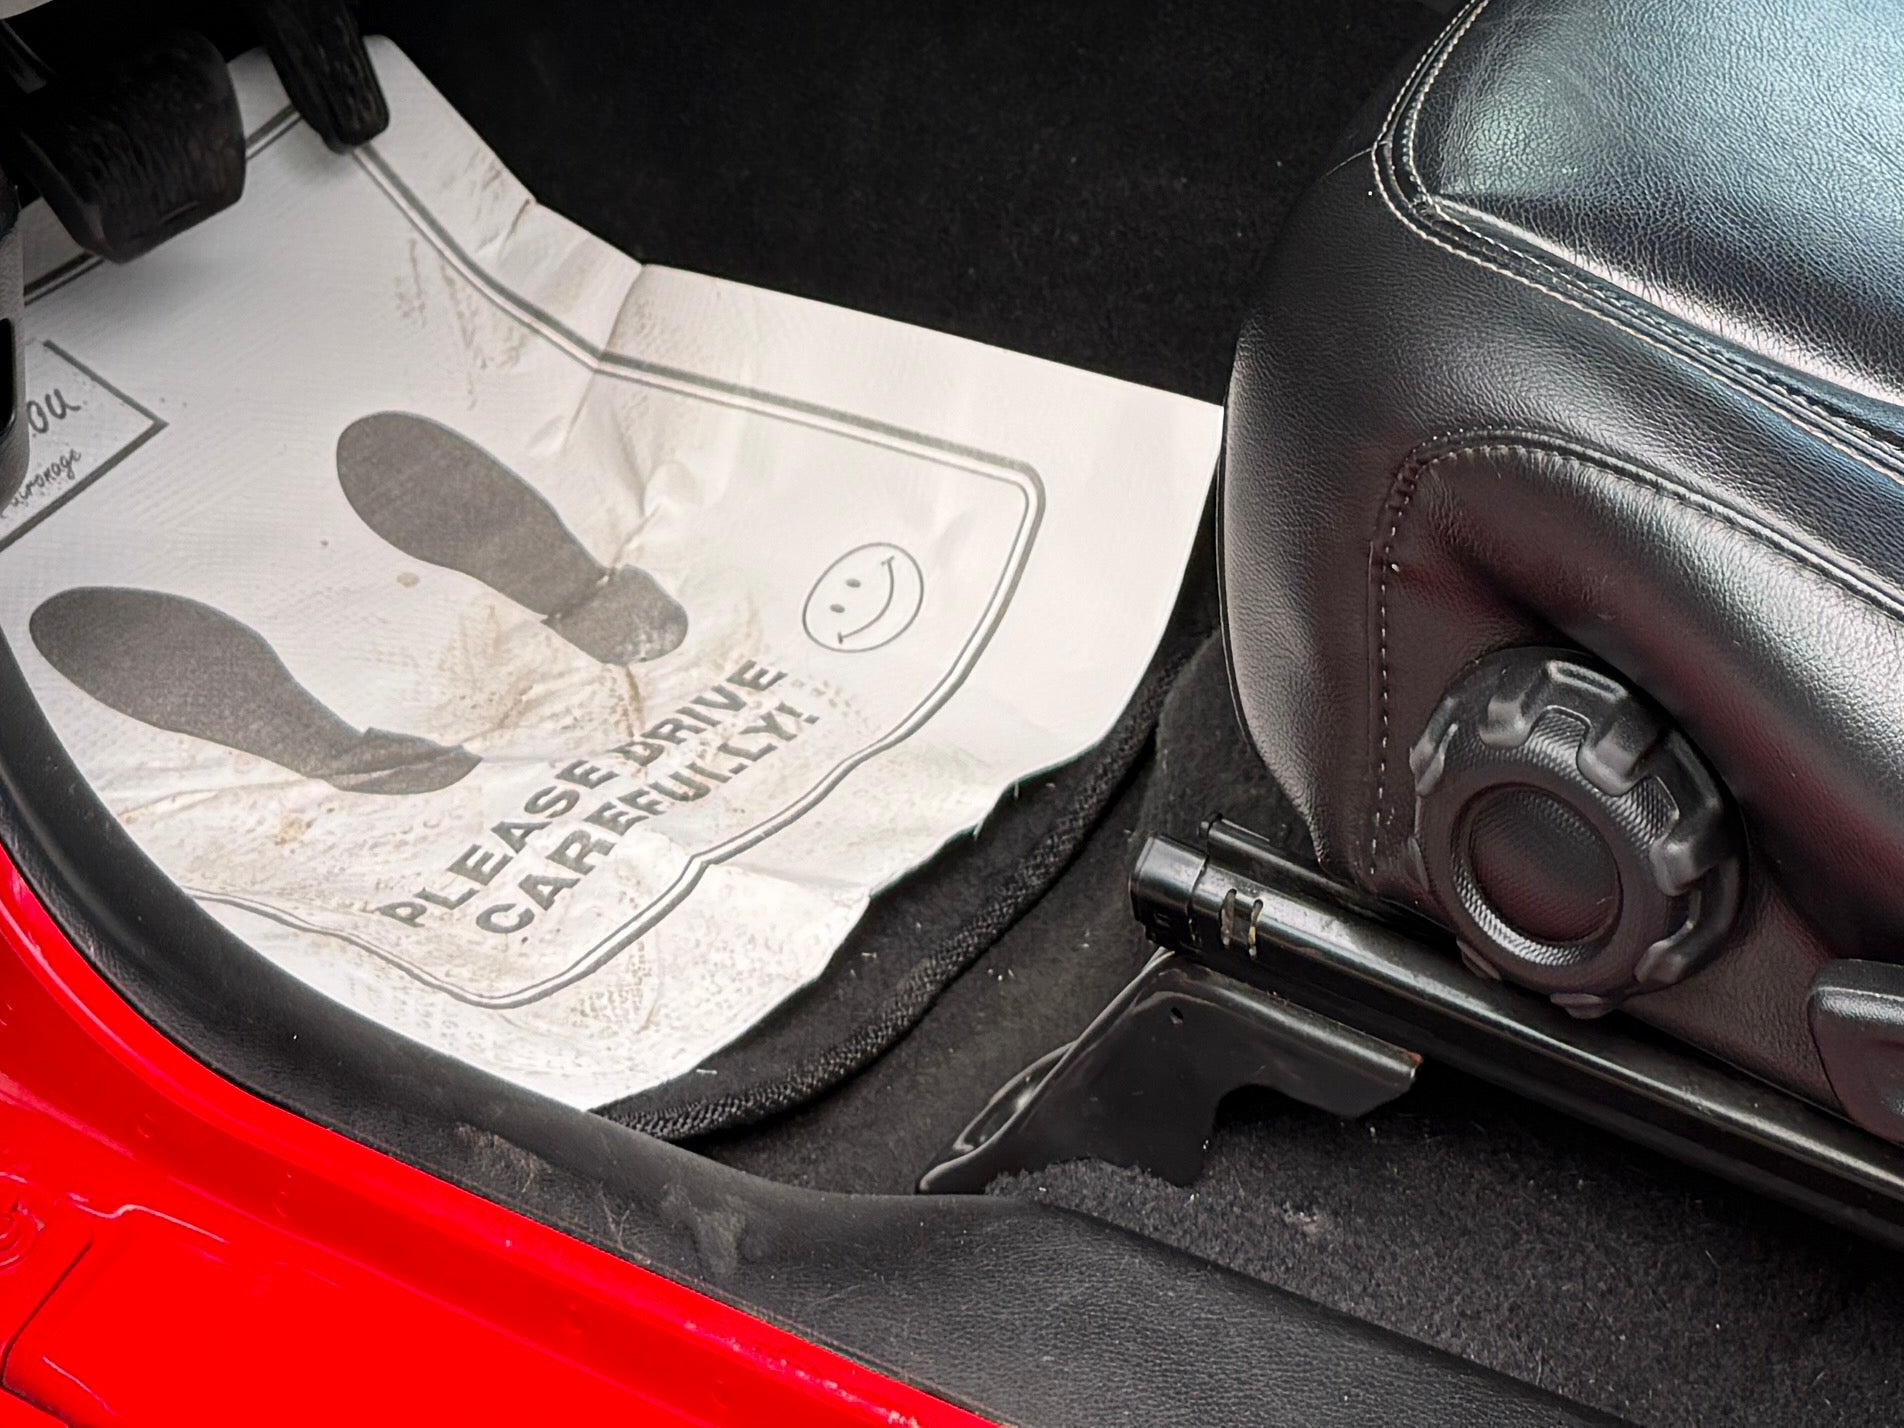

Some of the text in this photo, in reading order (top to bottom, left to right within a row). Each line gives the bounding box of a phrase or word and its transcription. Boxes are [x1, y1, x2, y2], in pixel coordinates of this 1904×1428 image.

[377, 659, 788, 928] PLEASE DRIVE
[475, 701, 820, 934] CAREFULLY!
